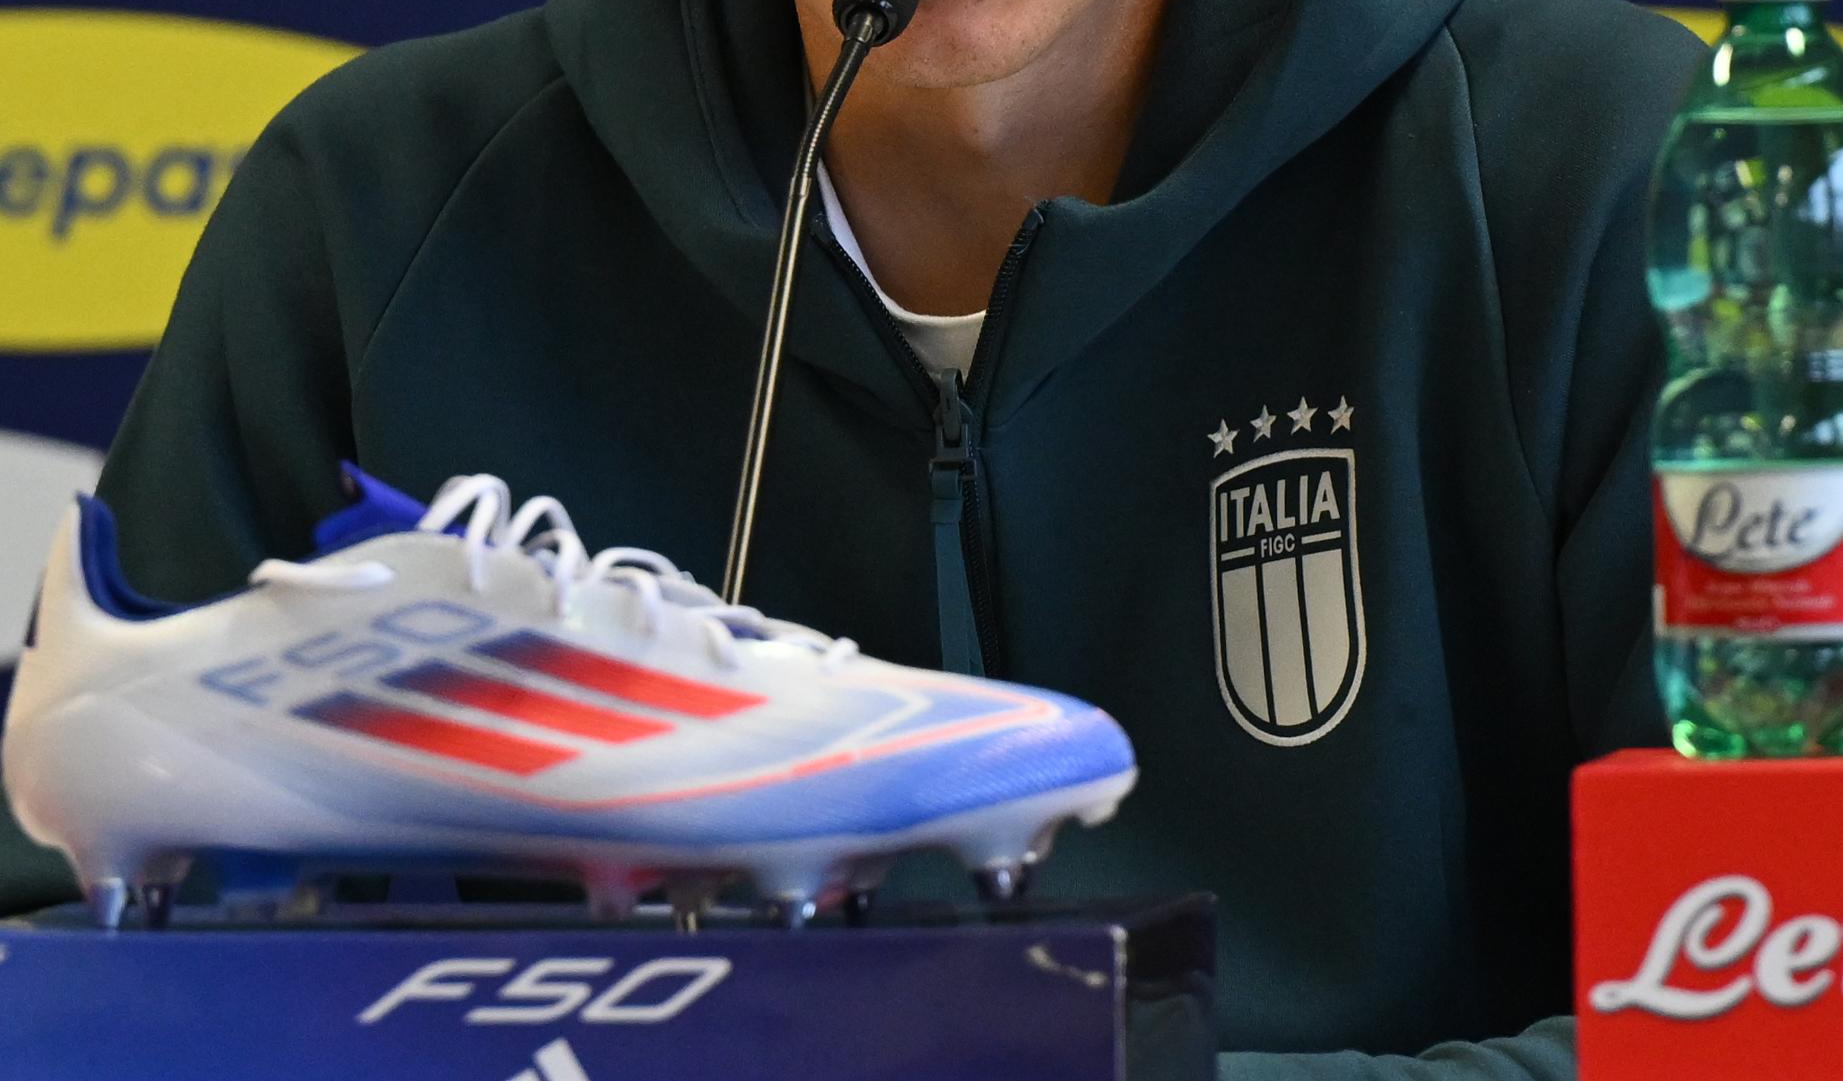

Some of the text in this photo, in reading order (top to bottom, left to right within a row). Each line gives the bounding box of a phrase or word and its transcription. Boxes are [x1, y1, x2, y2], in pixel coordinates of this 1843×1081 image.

[0, 145, 249, 238] epa
[1220, 471, 1340, 542] ITALIA
[1261, 533, 1296, 558] FIGC
[1684, 482, 1818, 565] Lete
[1589, 875, 1843, 1020] Le
